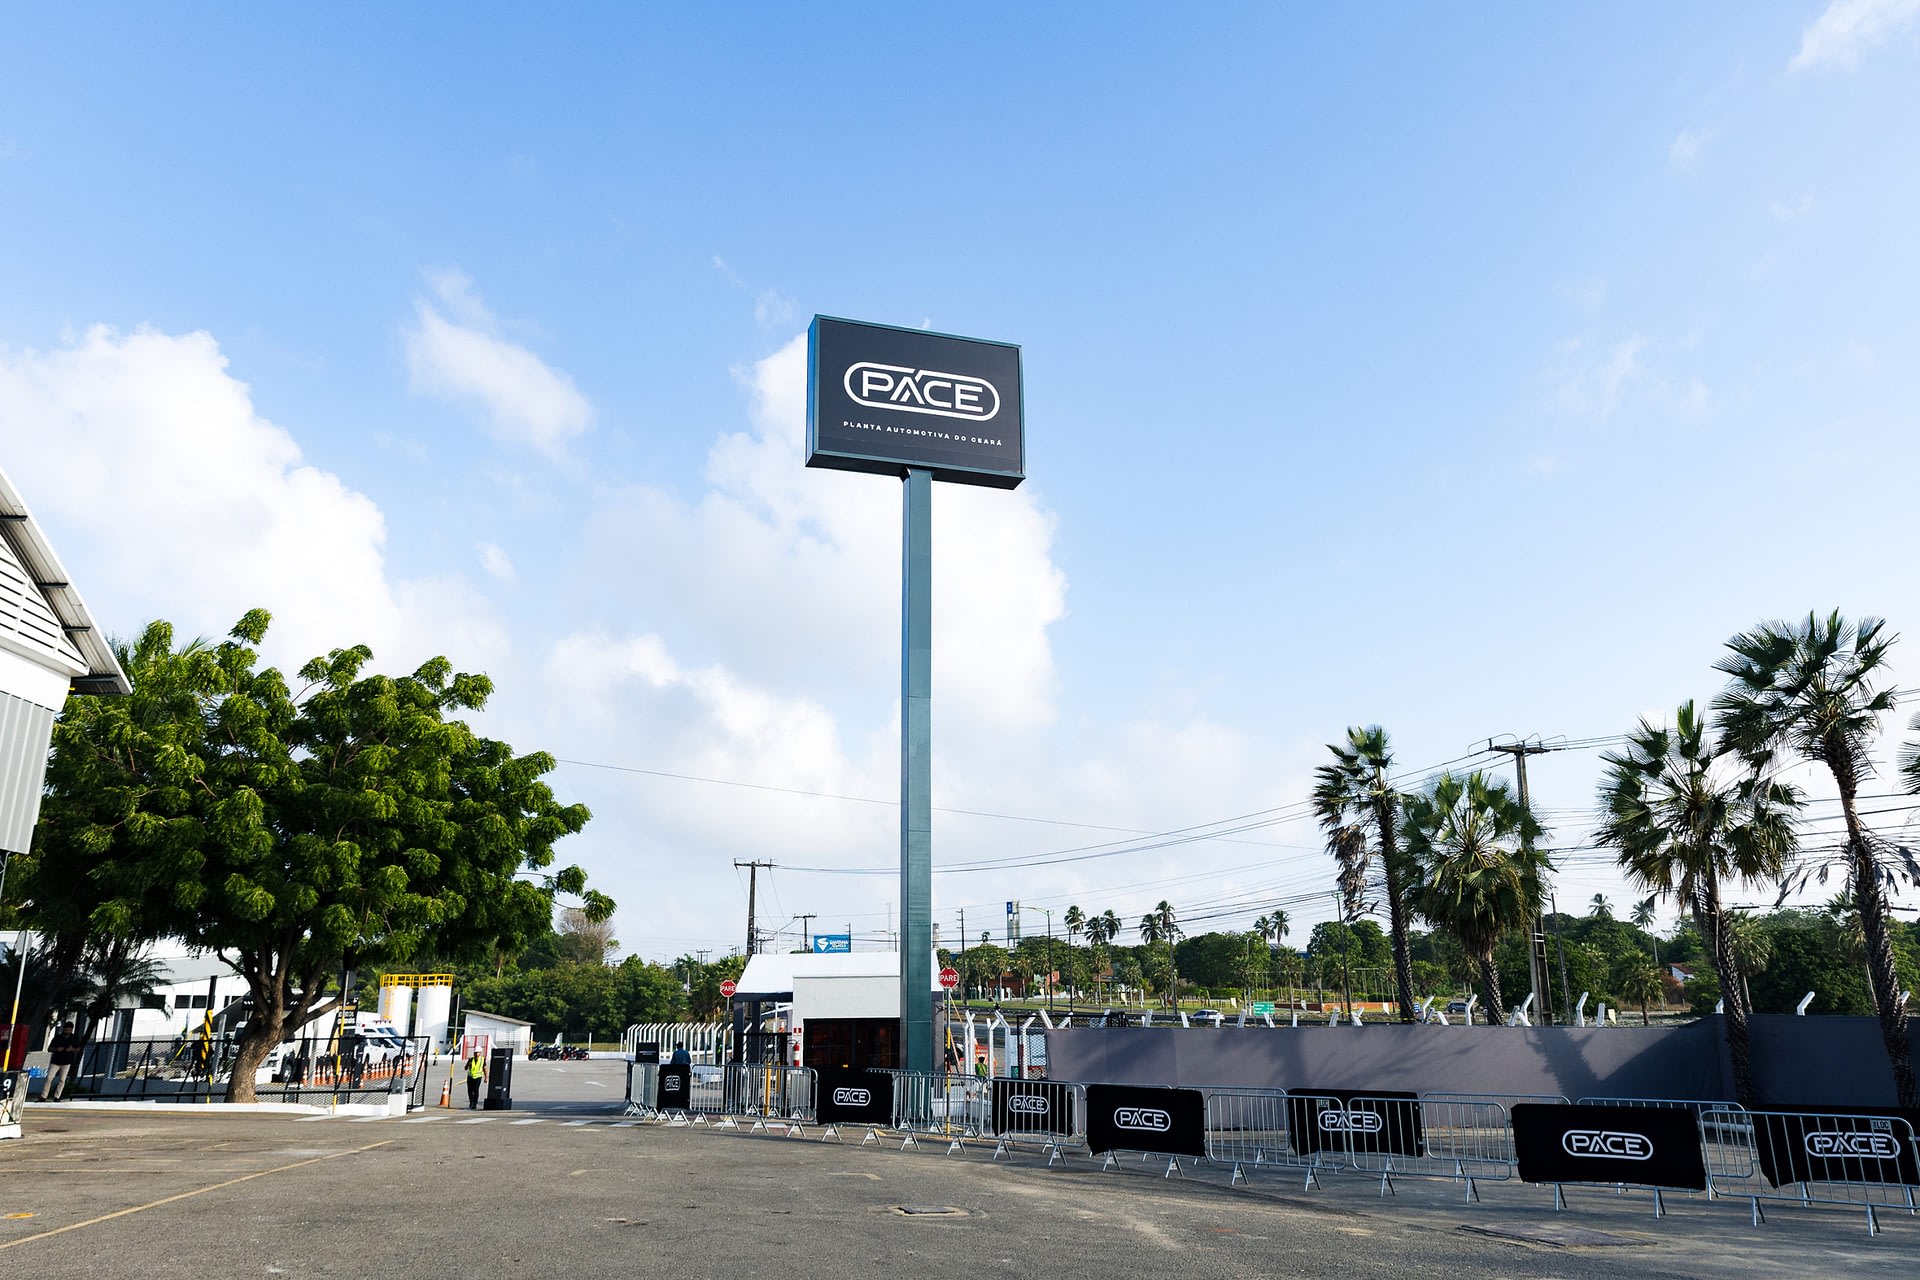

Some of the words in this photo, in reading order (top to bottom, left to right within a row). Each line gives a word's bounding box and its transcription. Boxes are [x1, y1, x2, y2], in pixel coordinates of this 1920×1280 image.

[861, 369, 984, 413] PACE
[843, 421, 882, 432] PLANTA
[886, 426, 950, 440] AUTOMOTIVA
[954, 434, 967, 442] DO
[971, 436, 1002, 446] CEARÁ
[940, 974, 958, 982] PARE
[3, 1078, 12, 1091] 9
[836, 1091, 867, 1103] PACE
[1012, 1098, 1045, 1111] PACE
[1119, 1111, 1165, 1128] PACE
[1324, 1114, 1376, 1129] PACE
[1571, 1135, 1644, 1155] PACE
[1813, 1136, 1891, 1154] PACE
